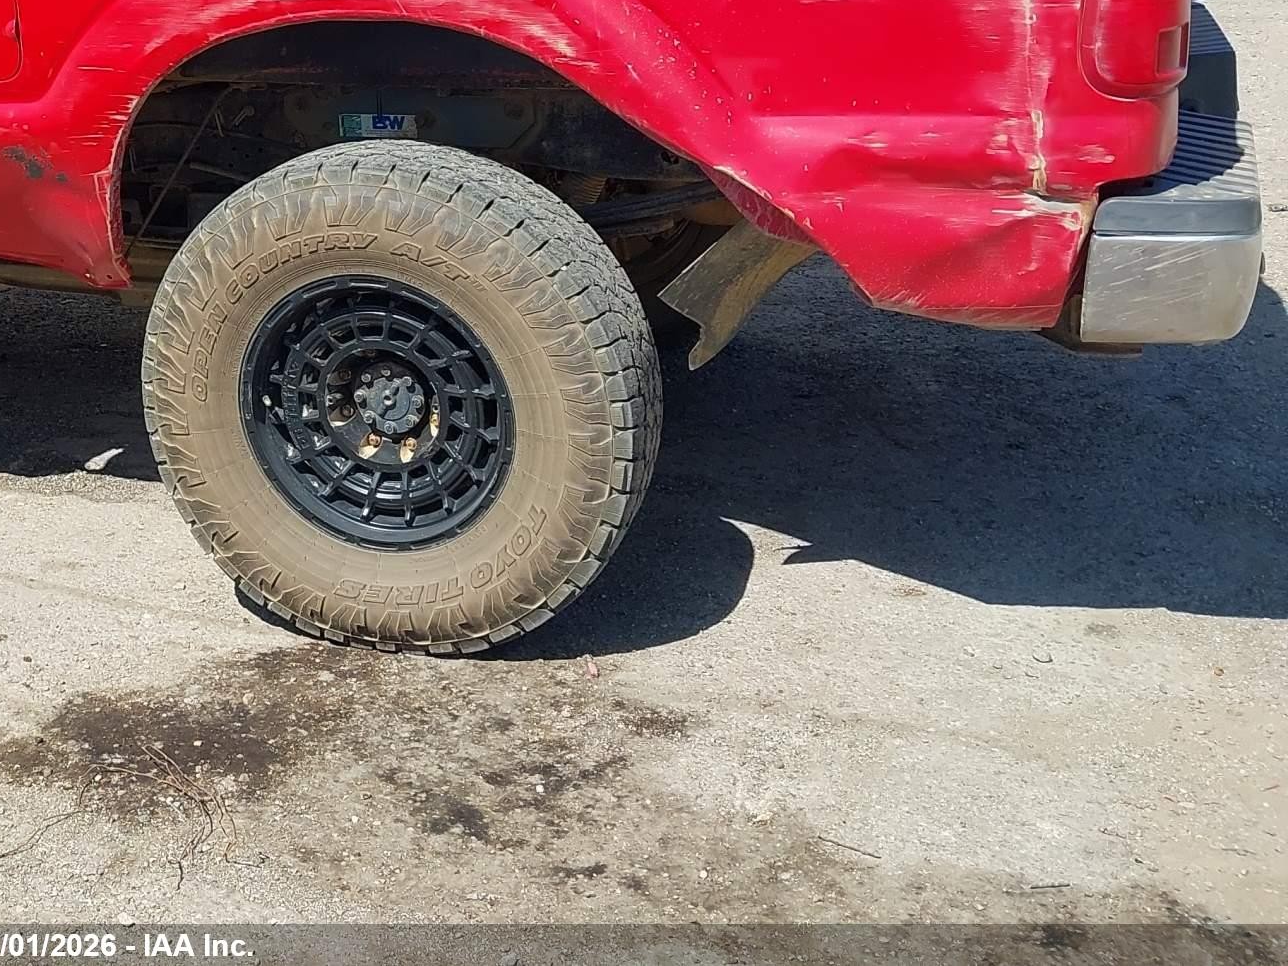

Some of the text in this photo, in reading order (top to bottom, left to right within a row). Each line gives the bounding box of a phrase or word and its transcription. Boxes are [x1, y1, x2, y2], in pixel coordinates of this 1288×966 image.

[191, 300, 228, 403] OPEN
[224, 231, 379, 306] COUNTRY
[389, 241, 471, 282] A/T
[469, 503, 548, 590] TOYO
[332, 576, 464, 606] TIRES
